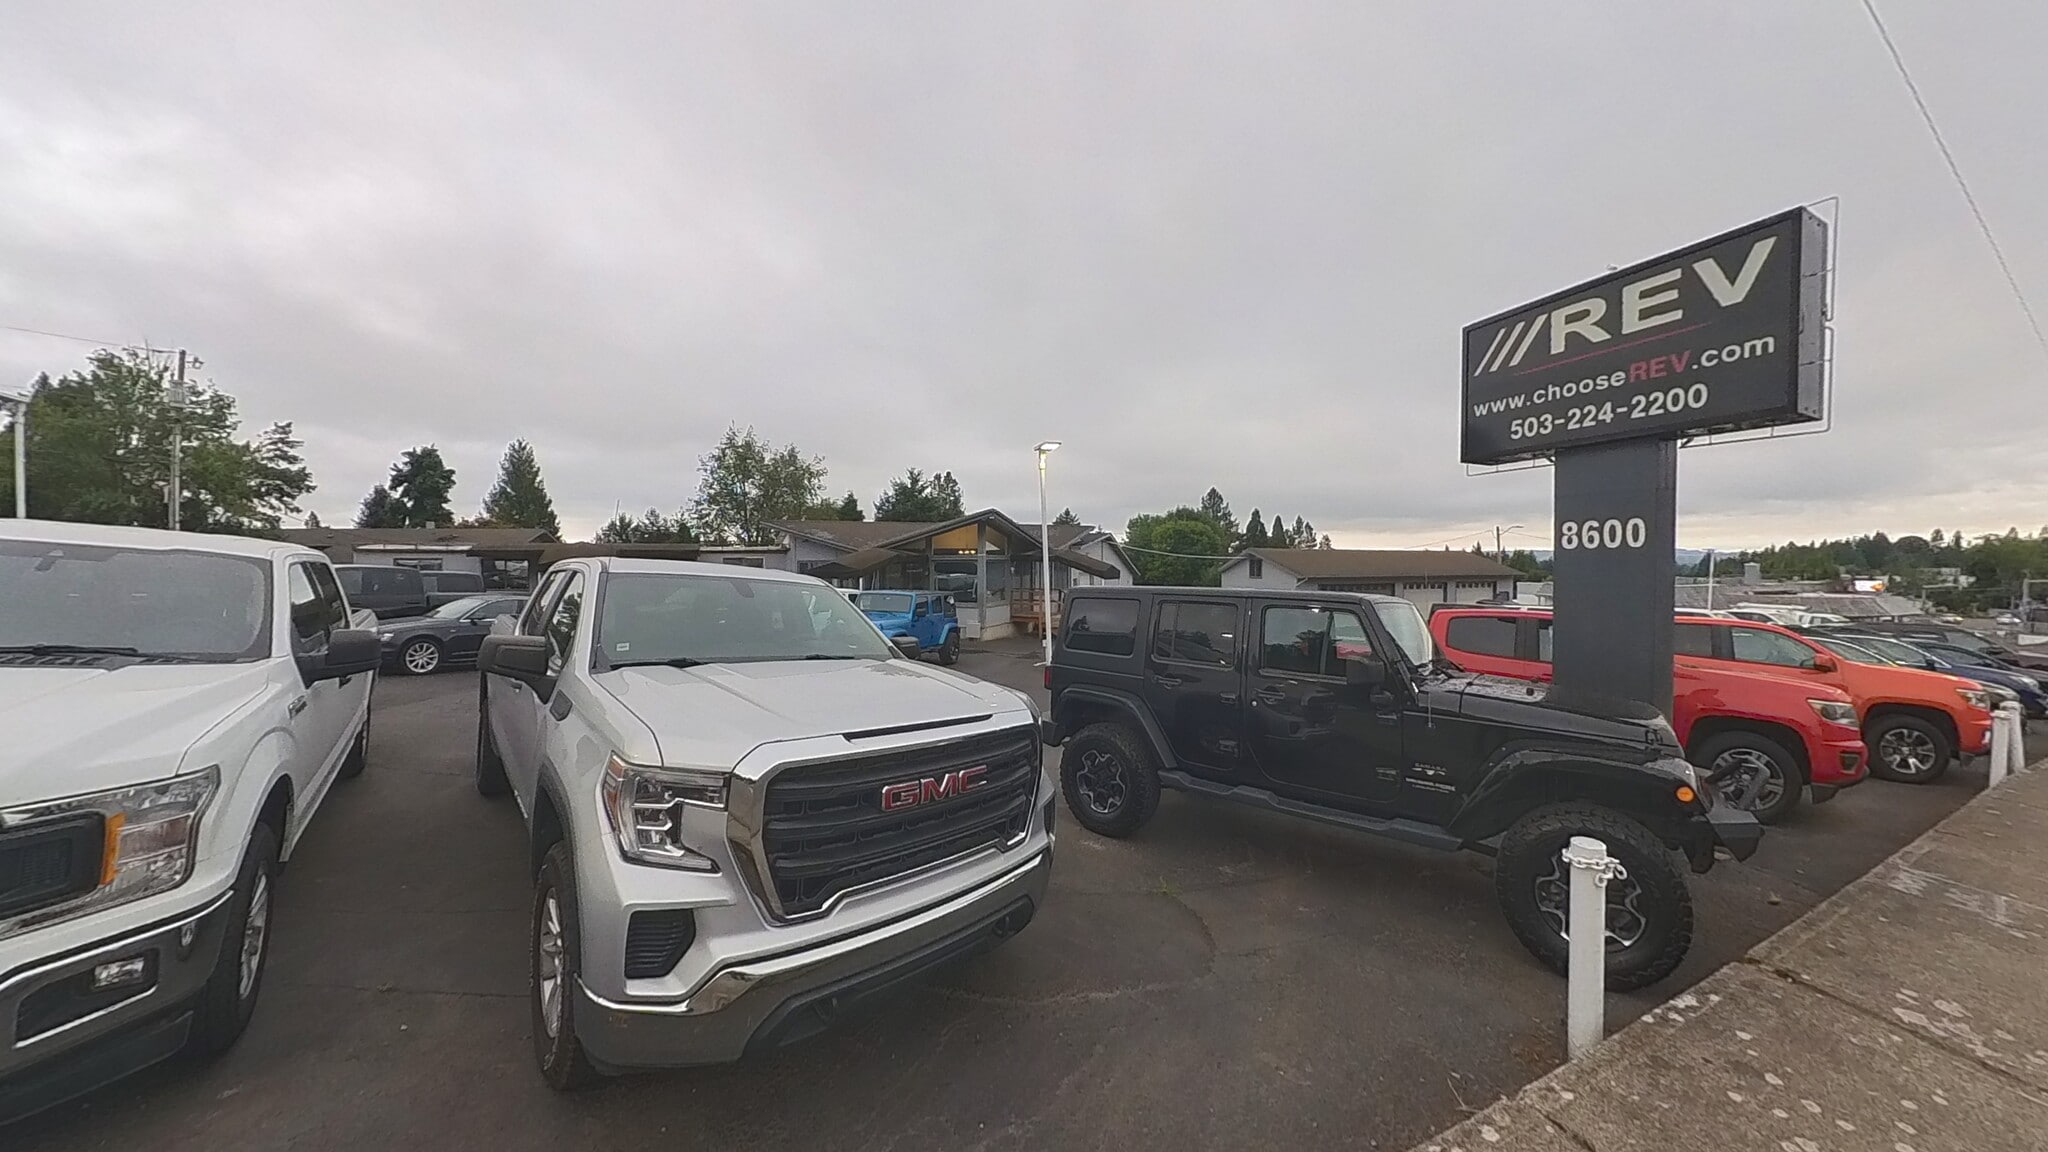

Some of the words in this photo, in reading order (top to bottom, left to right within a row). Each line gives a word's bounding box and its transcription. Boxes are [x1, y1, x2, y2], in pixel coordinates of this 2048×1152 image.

[1473, 336, 1775, 417] www.chooseREV.com
[1510, 383, 1709, 440] 503-224-2200
[1560, 518, 1647, 550] 8600
[882, 765, 988, 812] GMC
